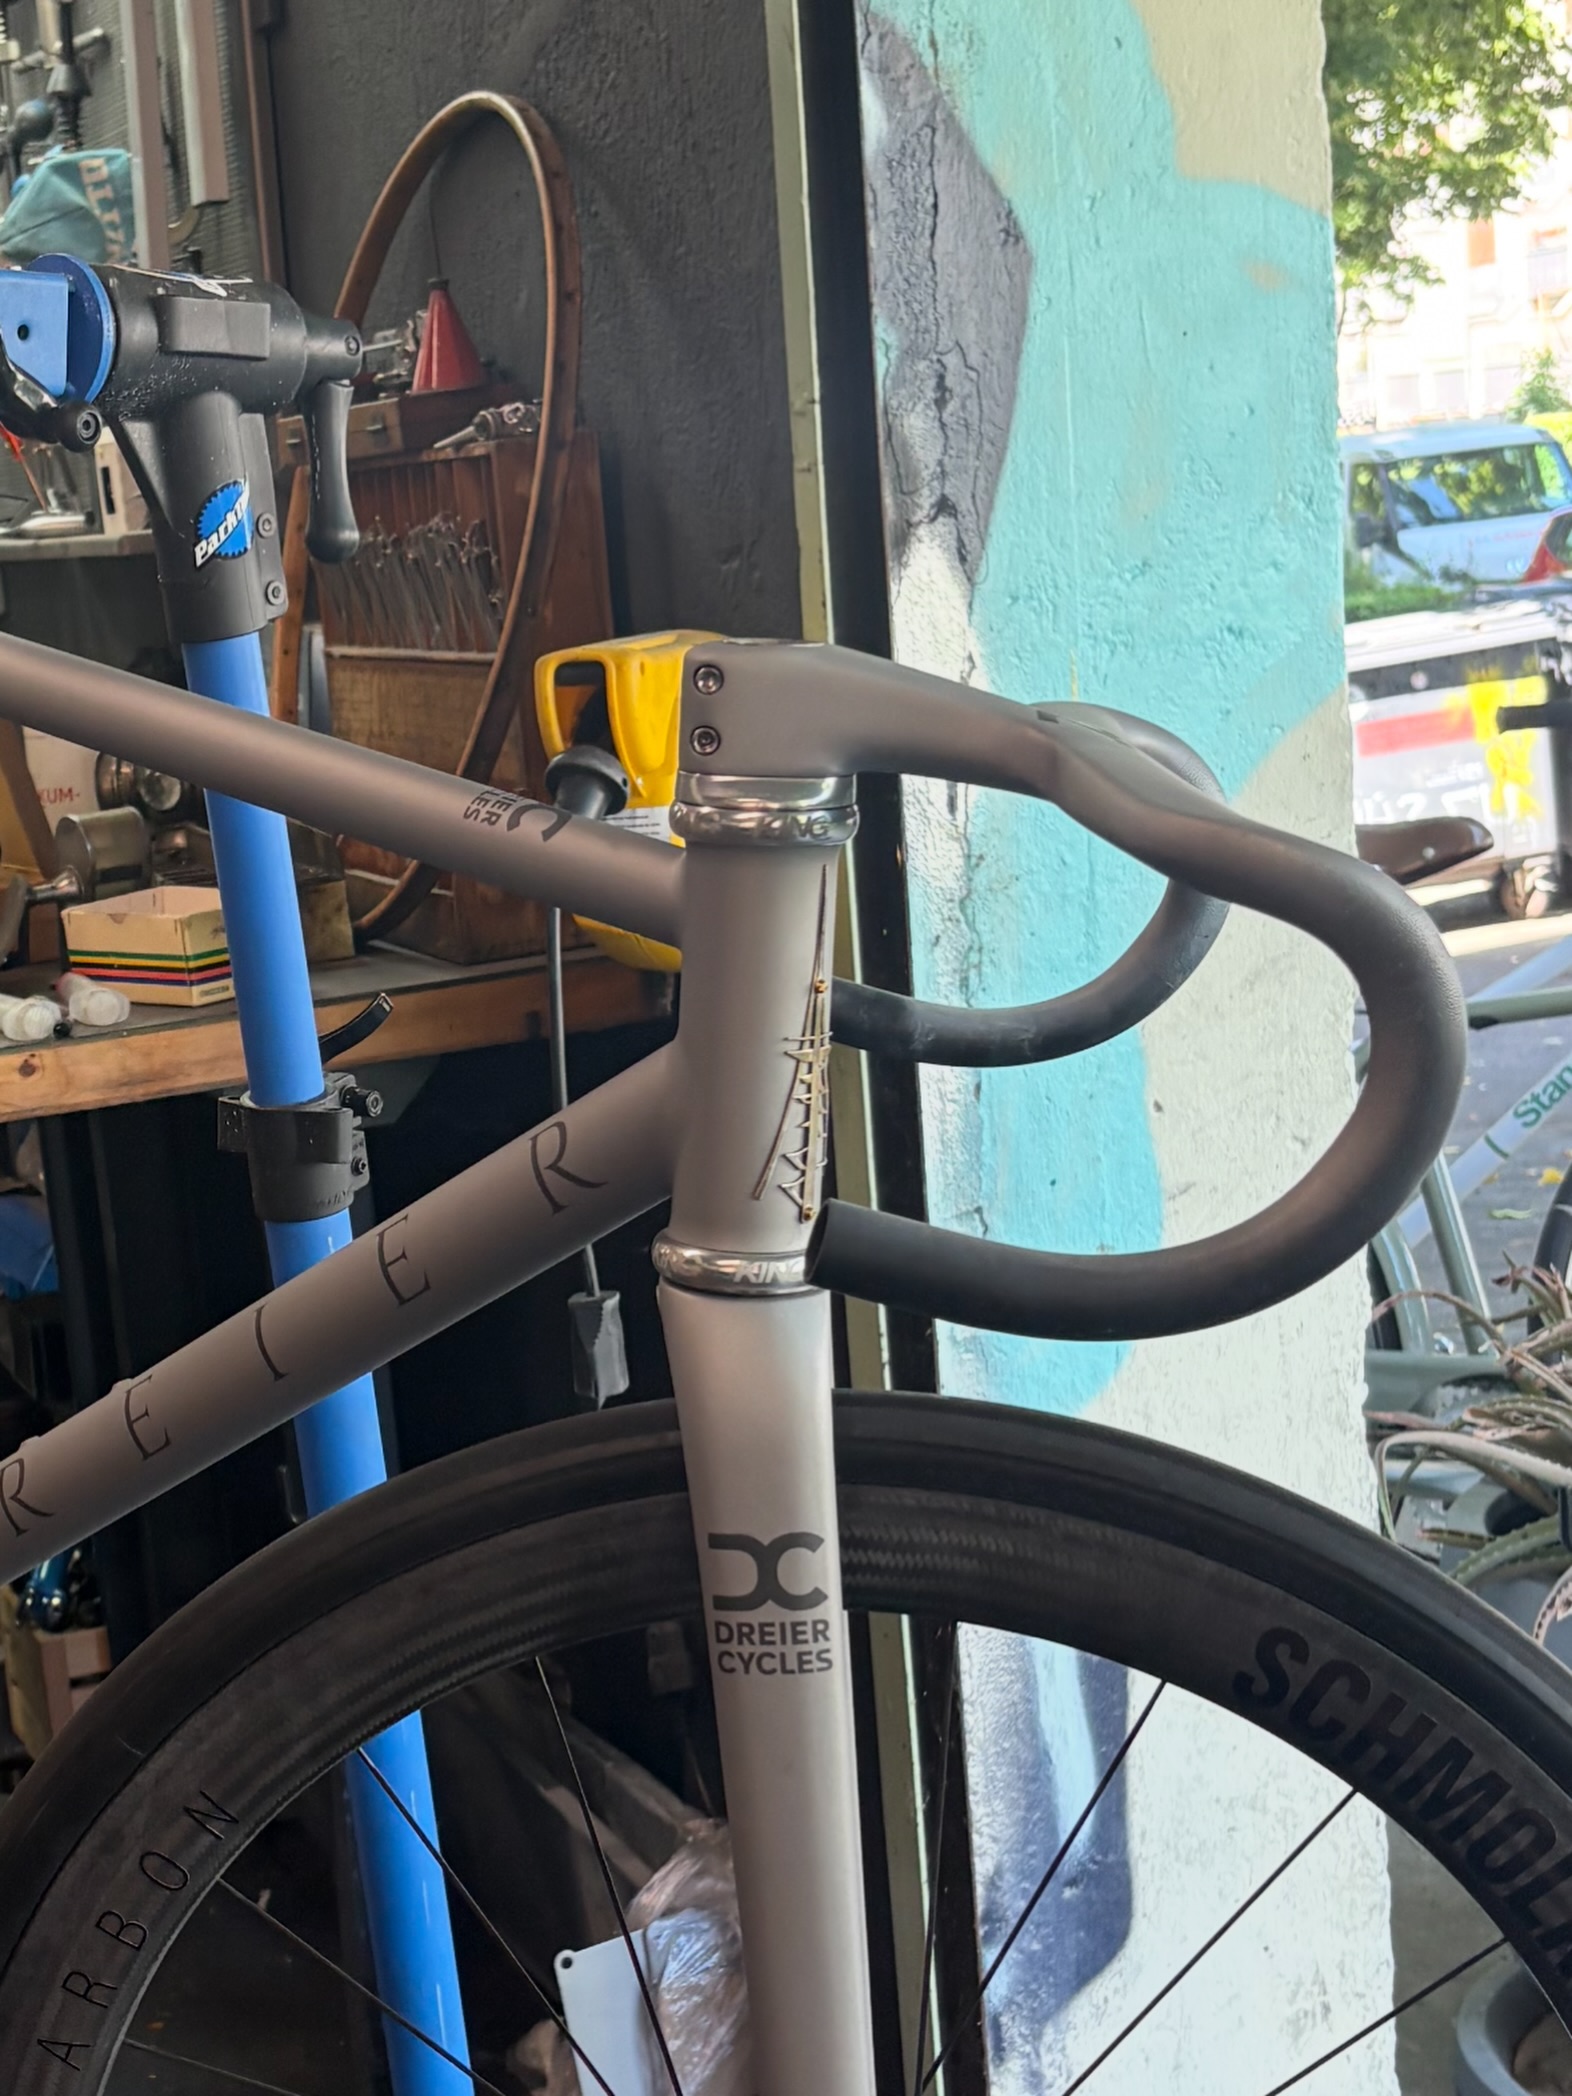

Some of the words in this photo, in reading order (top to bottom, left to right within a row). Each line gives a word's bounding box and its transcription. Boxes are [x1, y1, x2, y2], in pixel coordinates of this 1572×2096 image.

[714, 1619, 830, 1646] DREIER
[717, 1648, 833, 1675] CYCLES
[1232, 1626, 1572, 1978] SCHMOL
[37, 1790, 239, 2071] ARBON
